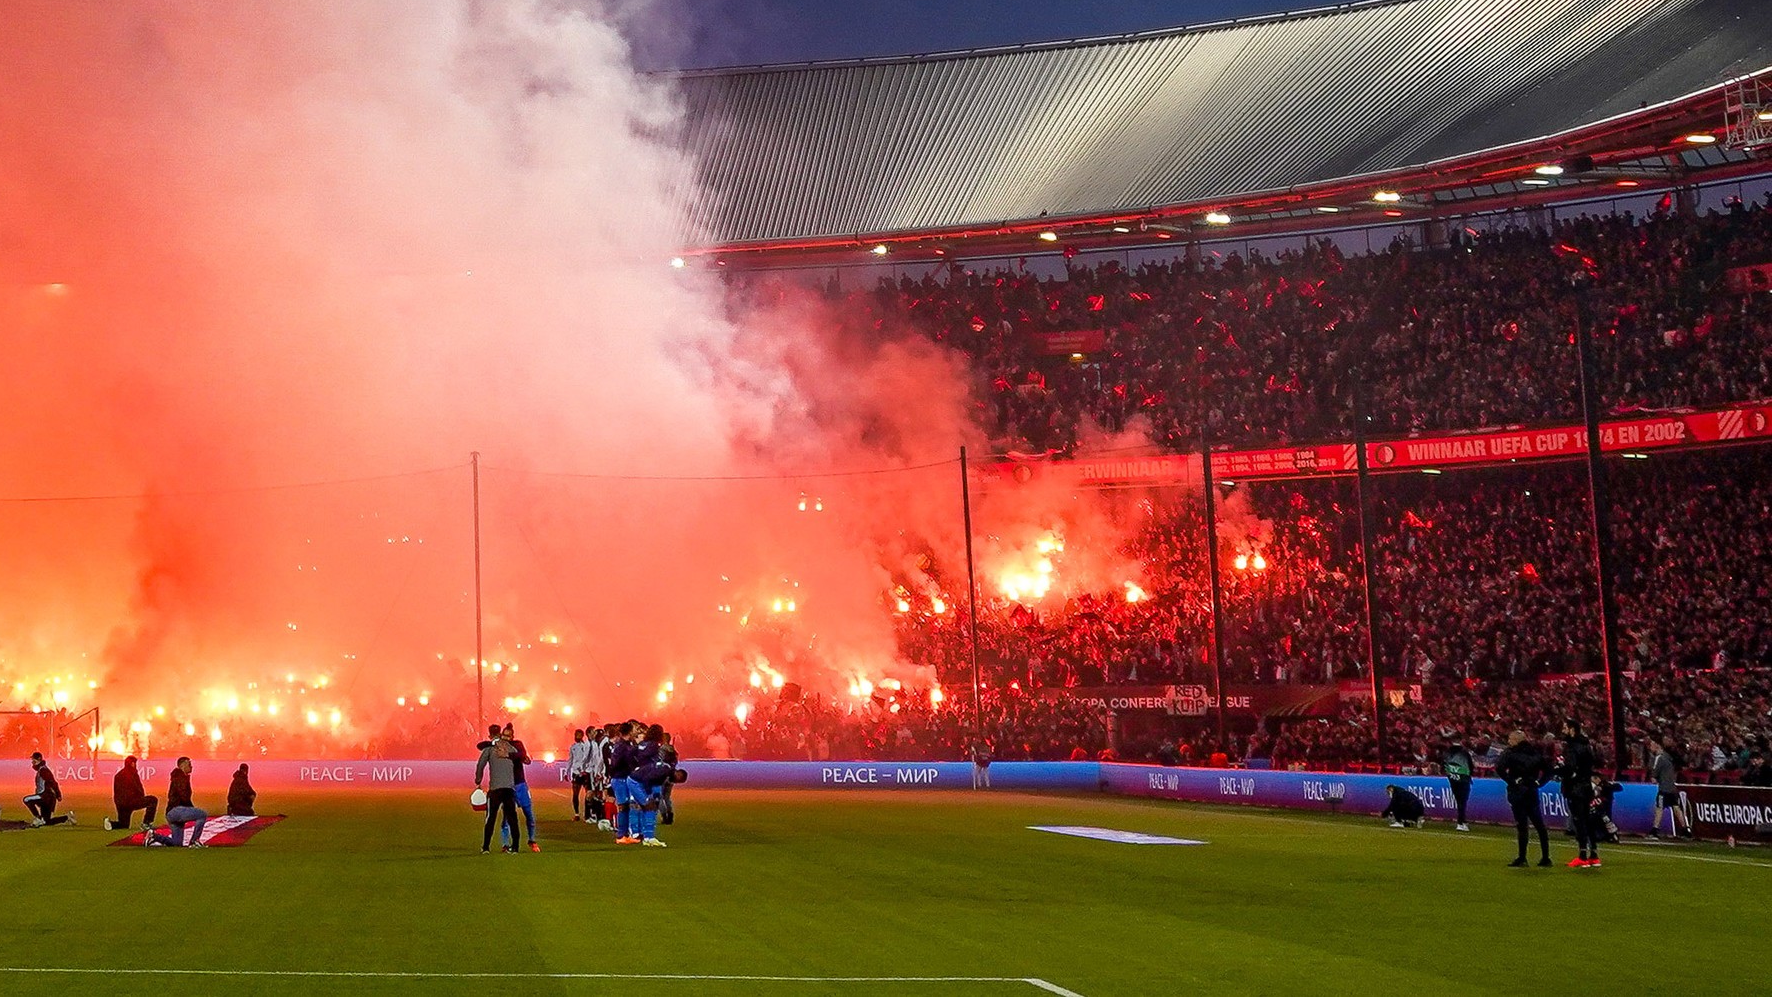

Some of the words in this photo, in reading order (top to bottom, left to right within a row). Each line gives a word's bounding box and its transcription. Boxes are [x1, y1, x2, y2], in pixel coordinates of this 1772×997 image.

[1407, 439, 1486, 461] WINNAAR
[1491, 435, 1532, 455] UEFA
[1536, 433, 1569, 452] CUP
[1618, 425, 1640, 444] EN
[1644, 421, 1686, 442] 2002
[1174, 685, 1204, 700] RED
[55, 766, 95, 781] EACE
[300, 766, 354, 782] PEACE
[822, 767, 878, 783] PEACE
[1303, 780, 1325, 801] PEACE
[1696, 802, 1724, 823] UEFA
[1723, 804, 1764, 825] EUROPA
